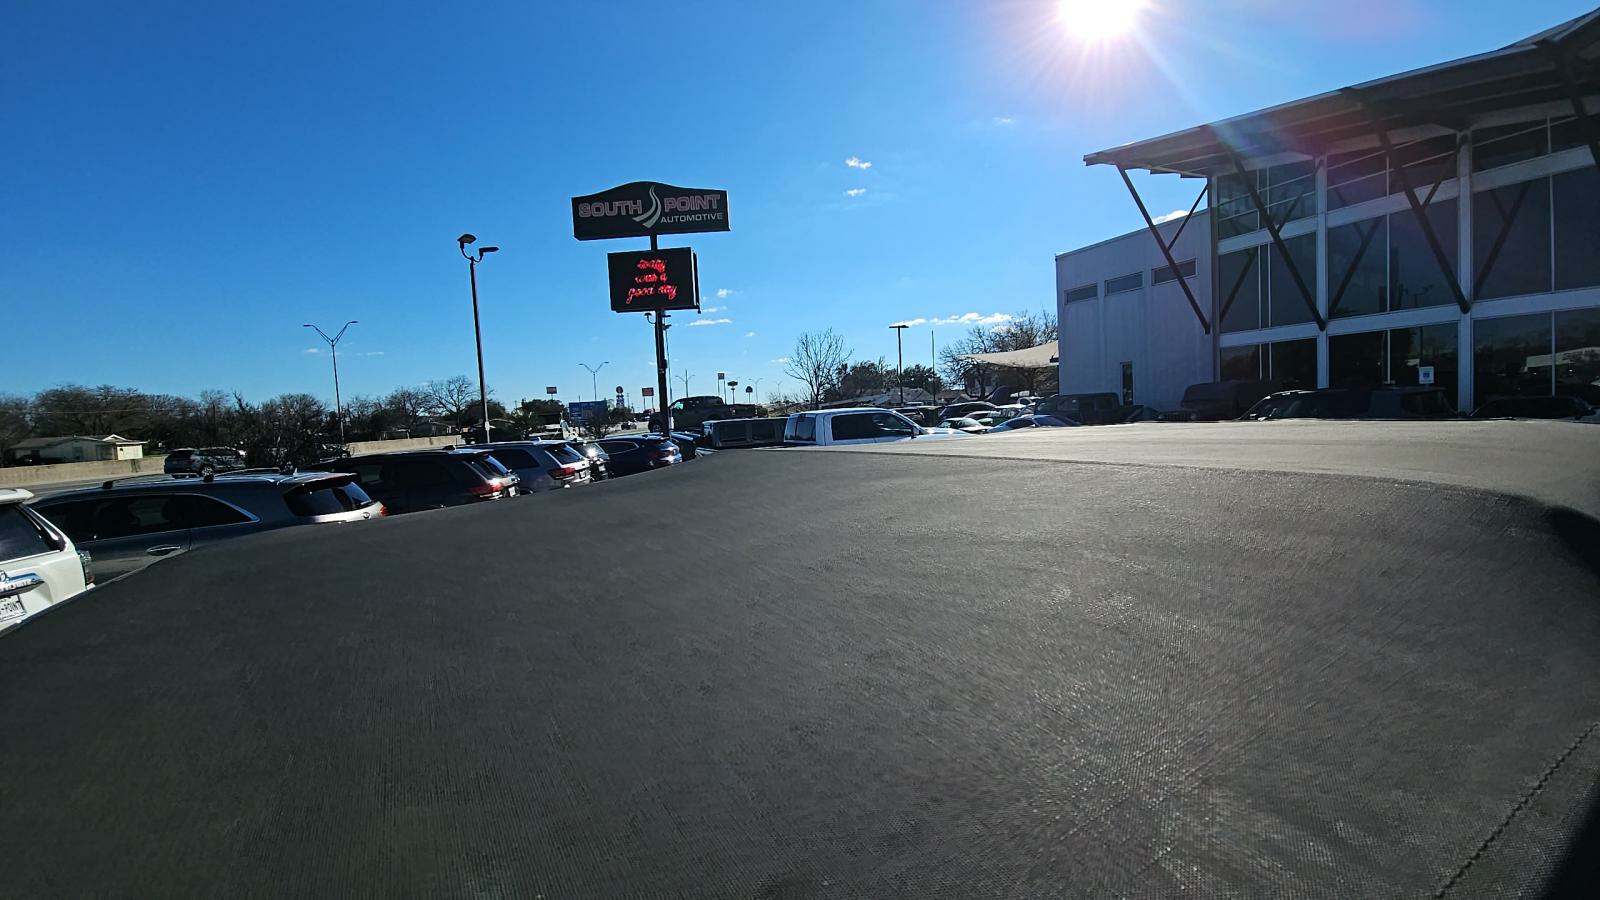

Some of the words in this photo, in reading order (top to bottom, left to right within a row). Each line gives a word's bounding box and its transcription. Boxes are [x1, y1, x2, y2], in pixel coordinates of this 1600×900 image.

[578, 200, 642, 217] SOUTH
[664, 195, 720, 212] POINT
[660, 213, 723, 223] AUTOMOTIVE
